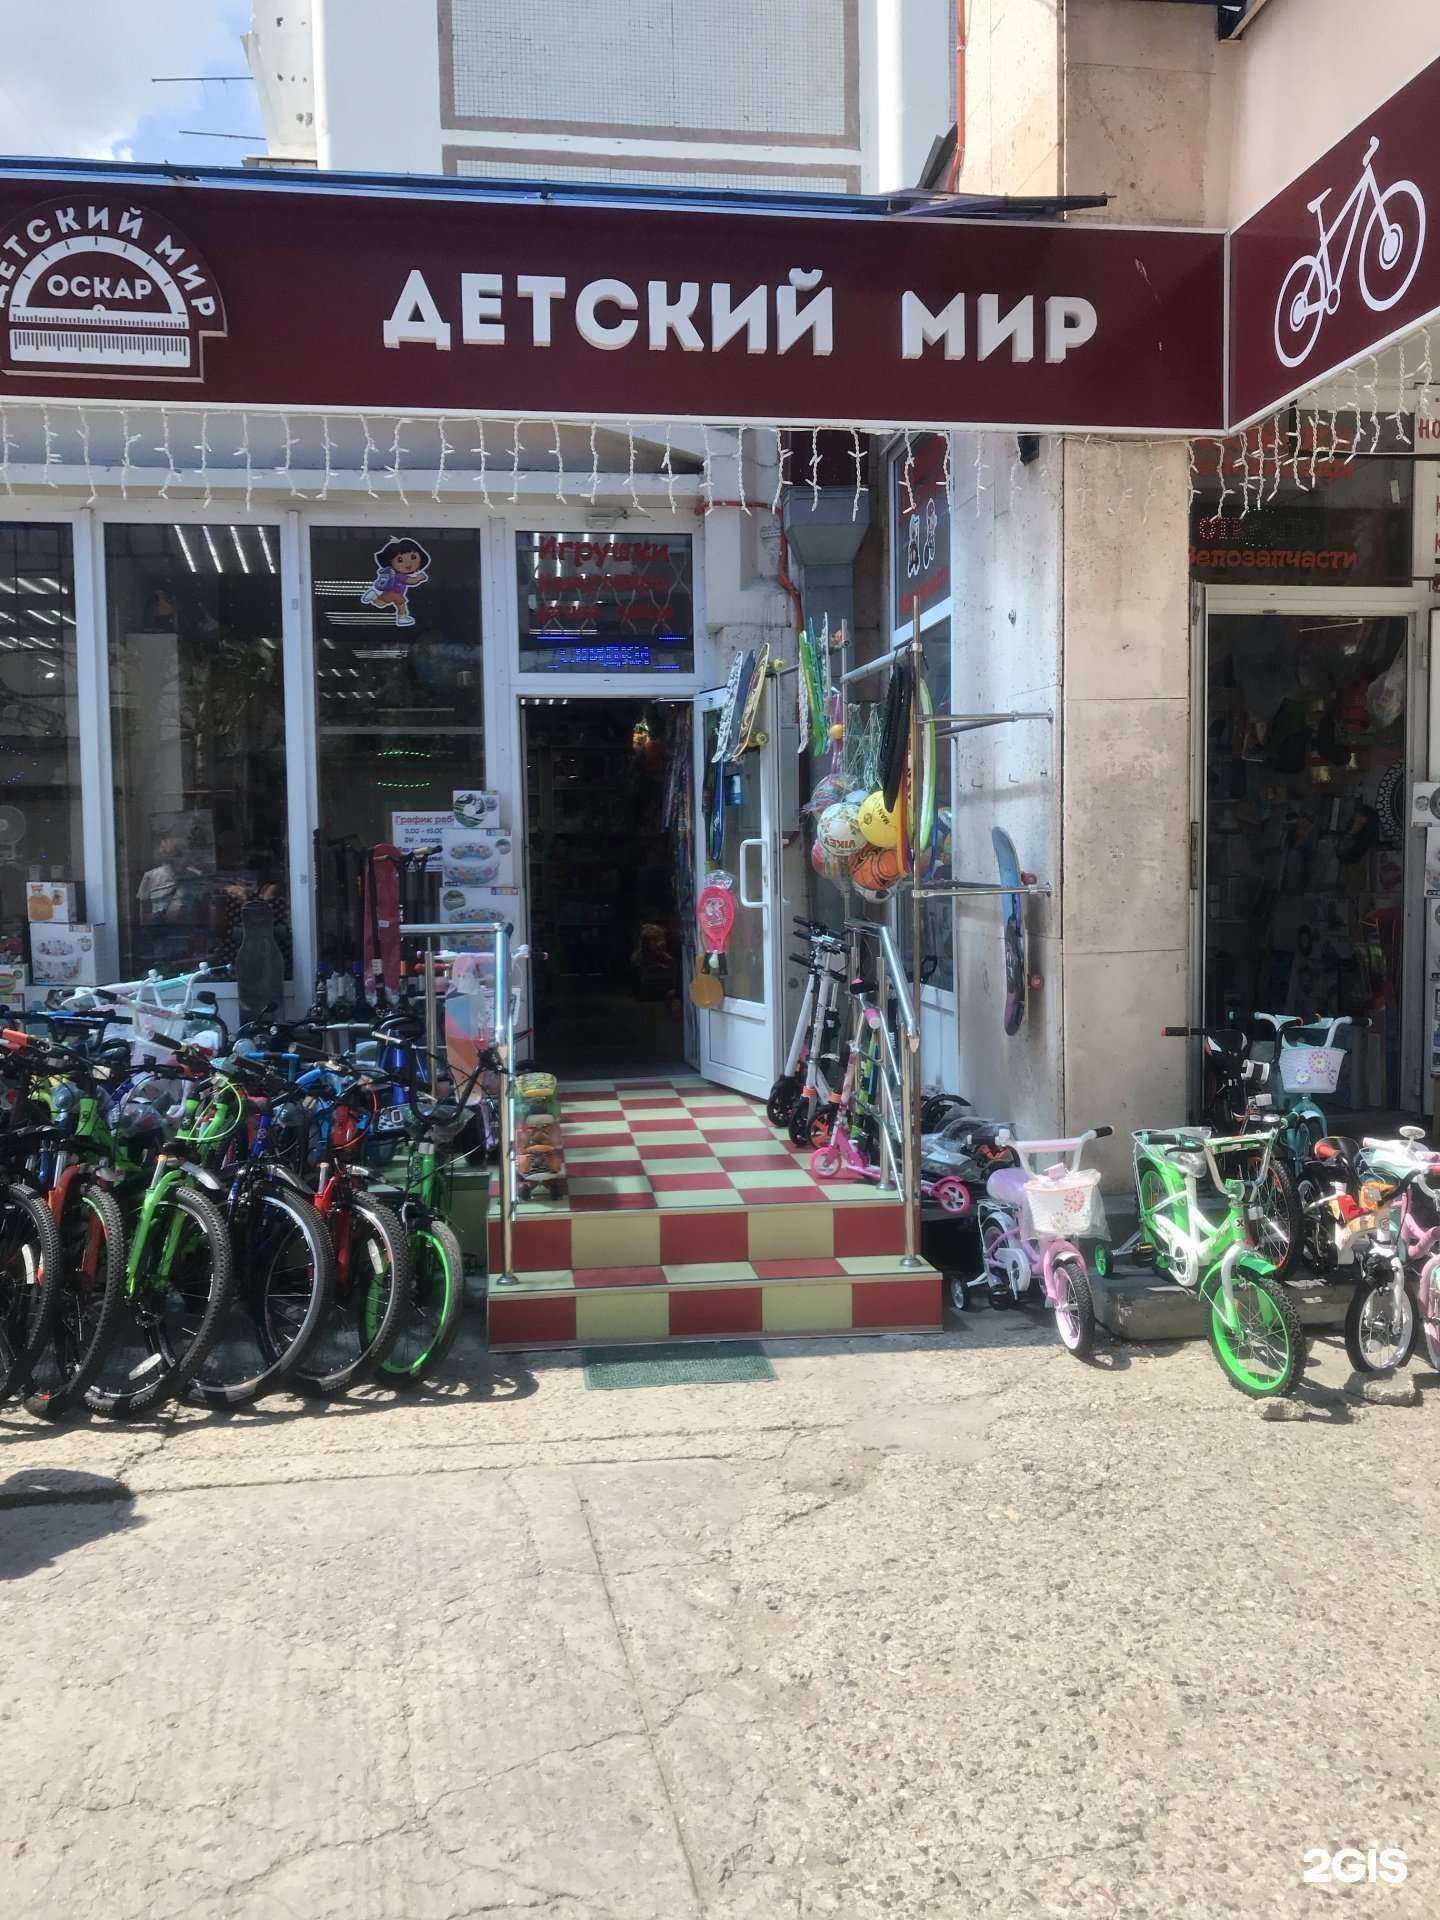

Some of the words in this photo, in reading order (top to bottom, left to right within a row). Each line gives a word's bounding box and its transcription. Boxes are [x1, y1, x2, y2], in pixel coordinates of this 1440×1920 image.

[47, 274, 152, 300] ОСКАР
[154, 234, 215, 316] МИР
[383, 268, 833, 357] ДЕТСКИЙ
[899, 290, 1098, 364] МИР
